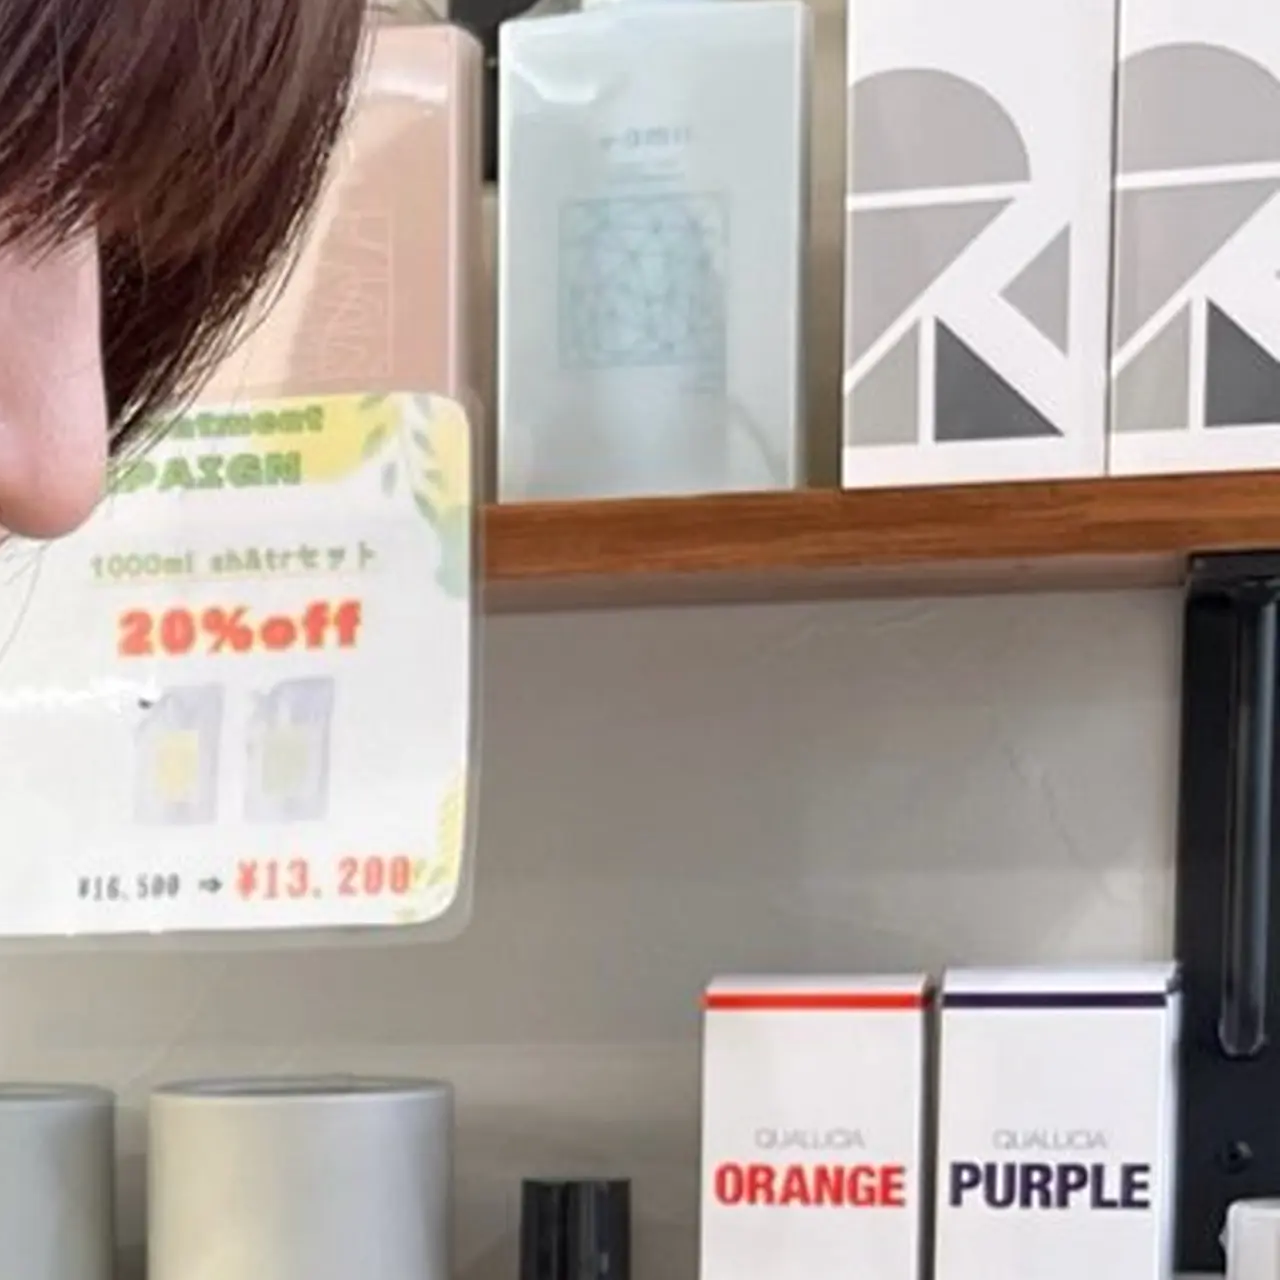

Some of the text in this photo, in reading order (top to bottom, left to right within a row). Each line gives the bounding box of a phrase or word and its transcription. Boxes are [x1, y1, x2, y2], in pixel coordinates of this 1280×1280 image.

[117, 600, 362, 657] 20%off
[713, 1160, 908, 1209] ORANGE
[947, 1160, 1152, 1210] PURPLE
